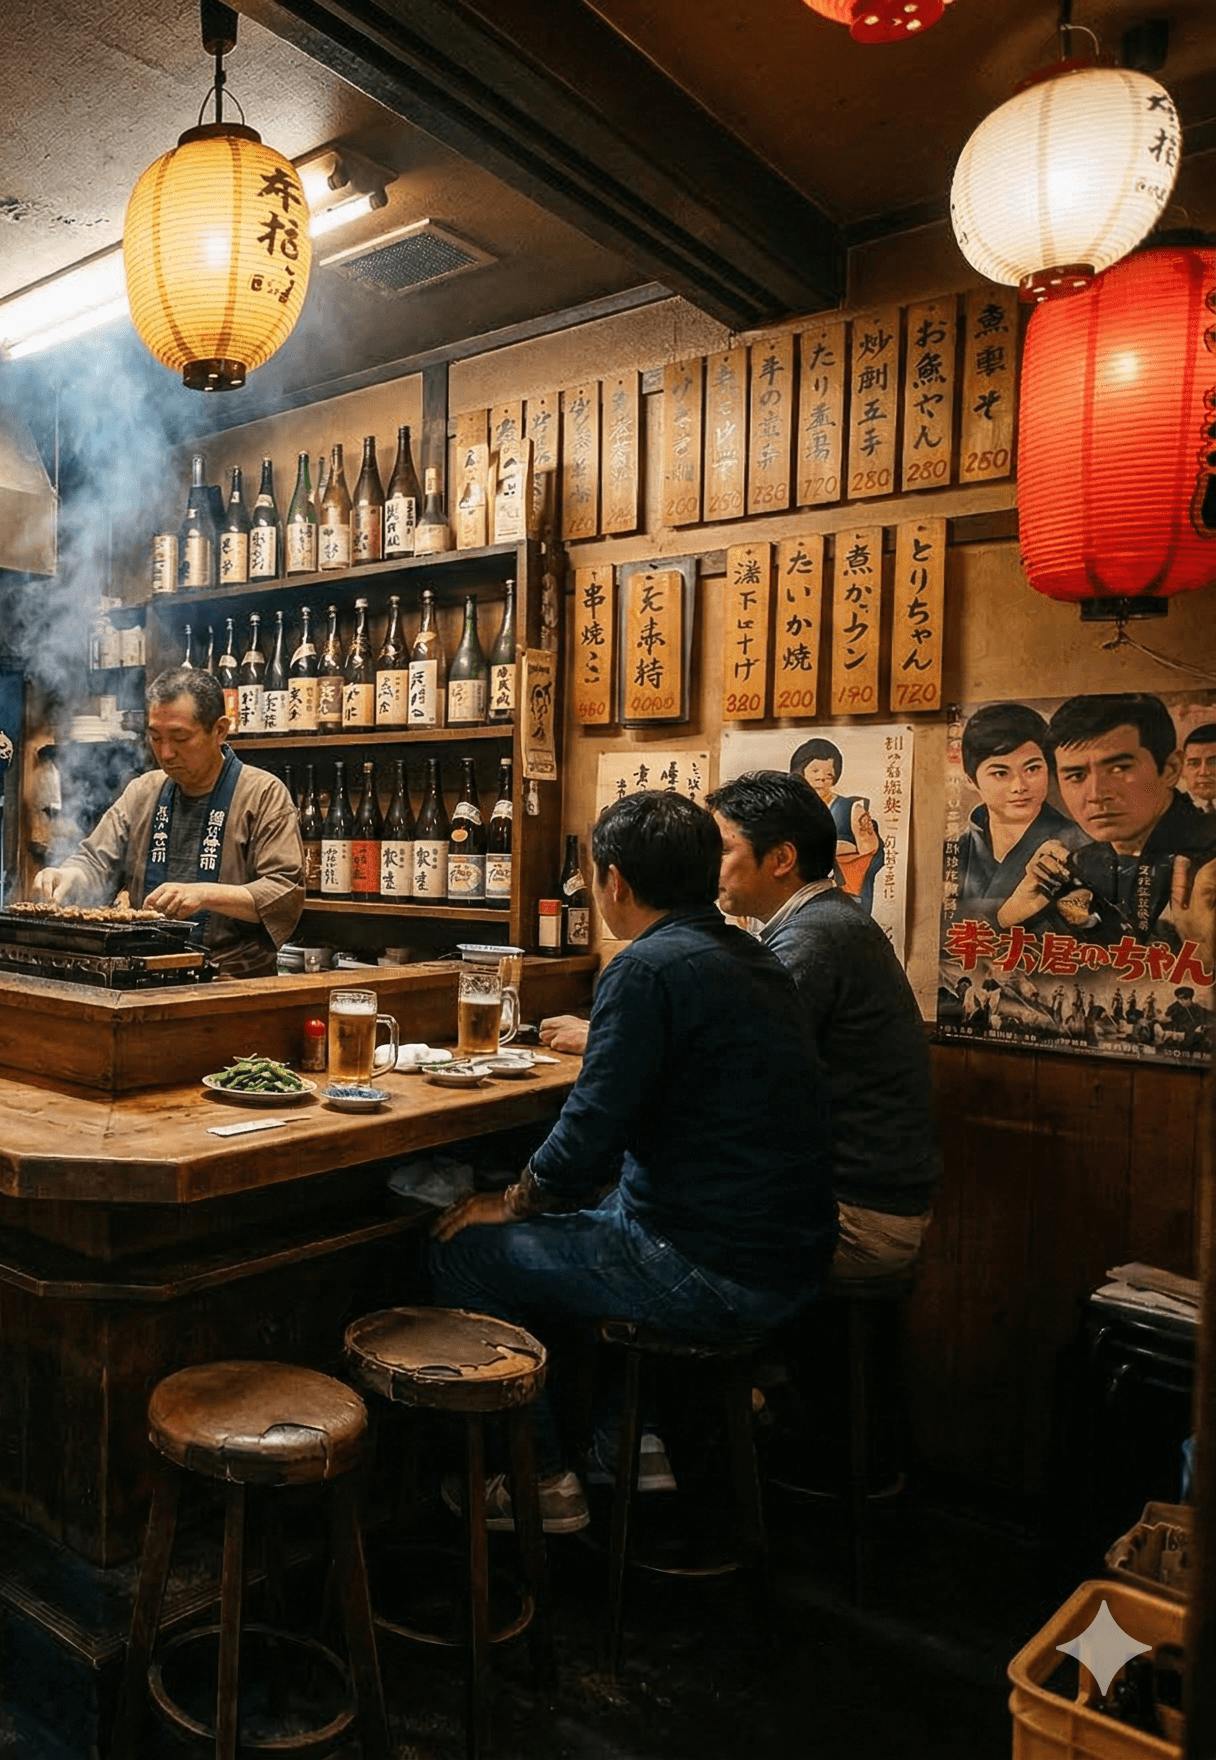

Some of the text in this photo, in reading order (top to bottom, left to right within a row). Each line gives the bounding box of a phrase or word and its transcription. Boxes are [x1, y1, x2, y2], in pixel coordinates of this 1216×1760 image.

[852, 468, 891, 491] 280
[907, 459, 947, 482] 280
[782, 550, 814, 672] たいか焼
[901, 538, 933, 671] とりちゃん
[777, 689, 814, 709] 200
[896, 682, 938, 705] 720
